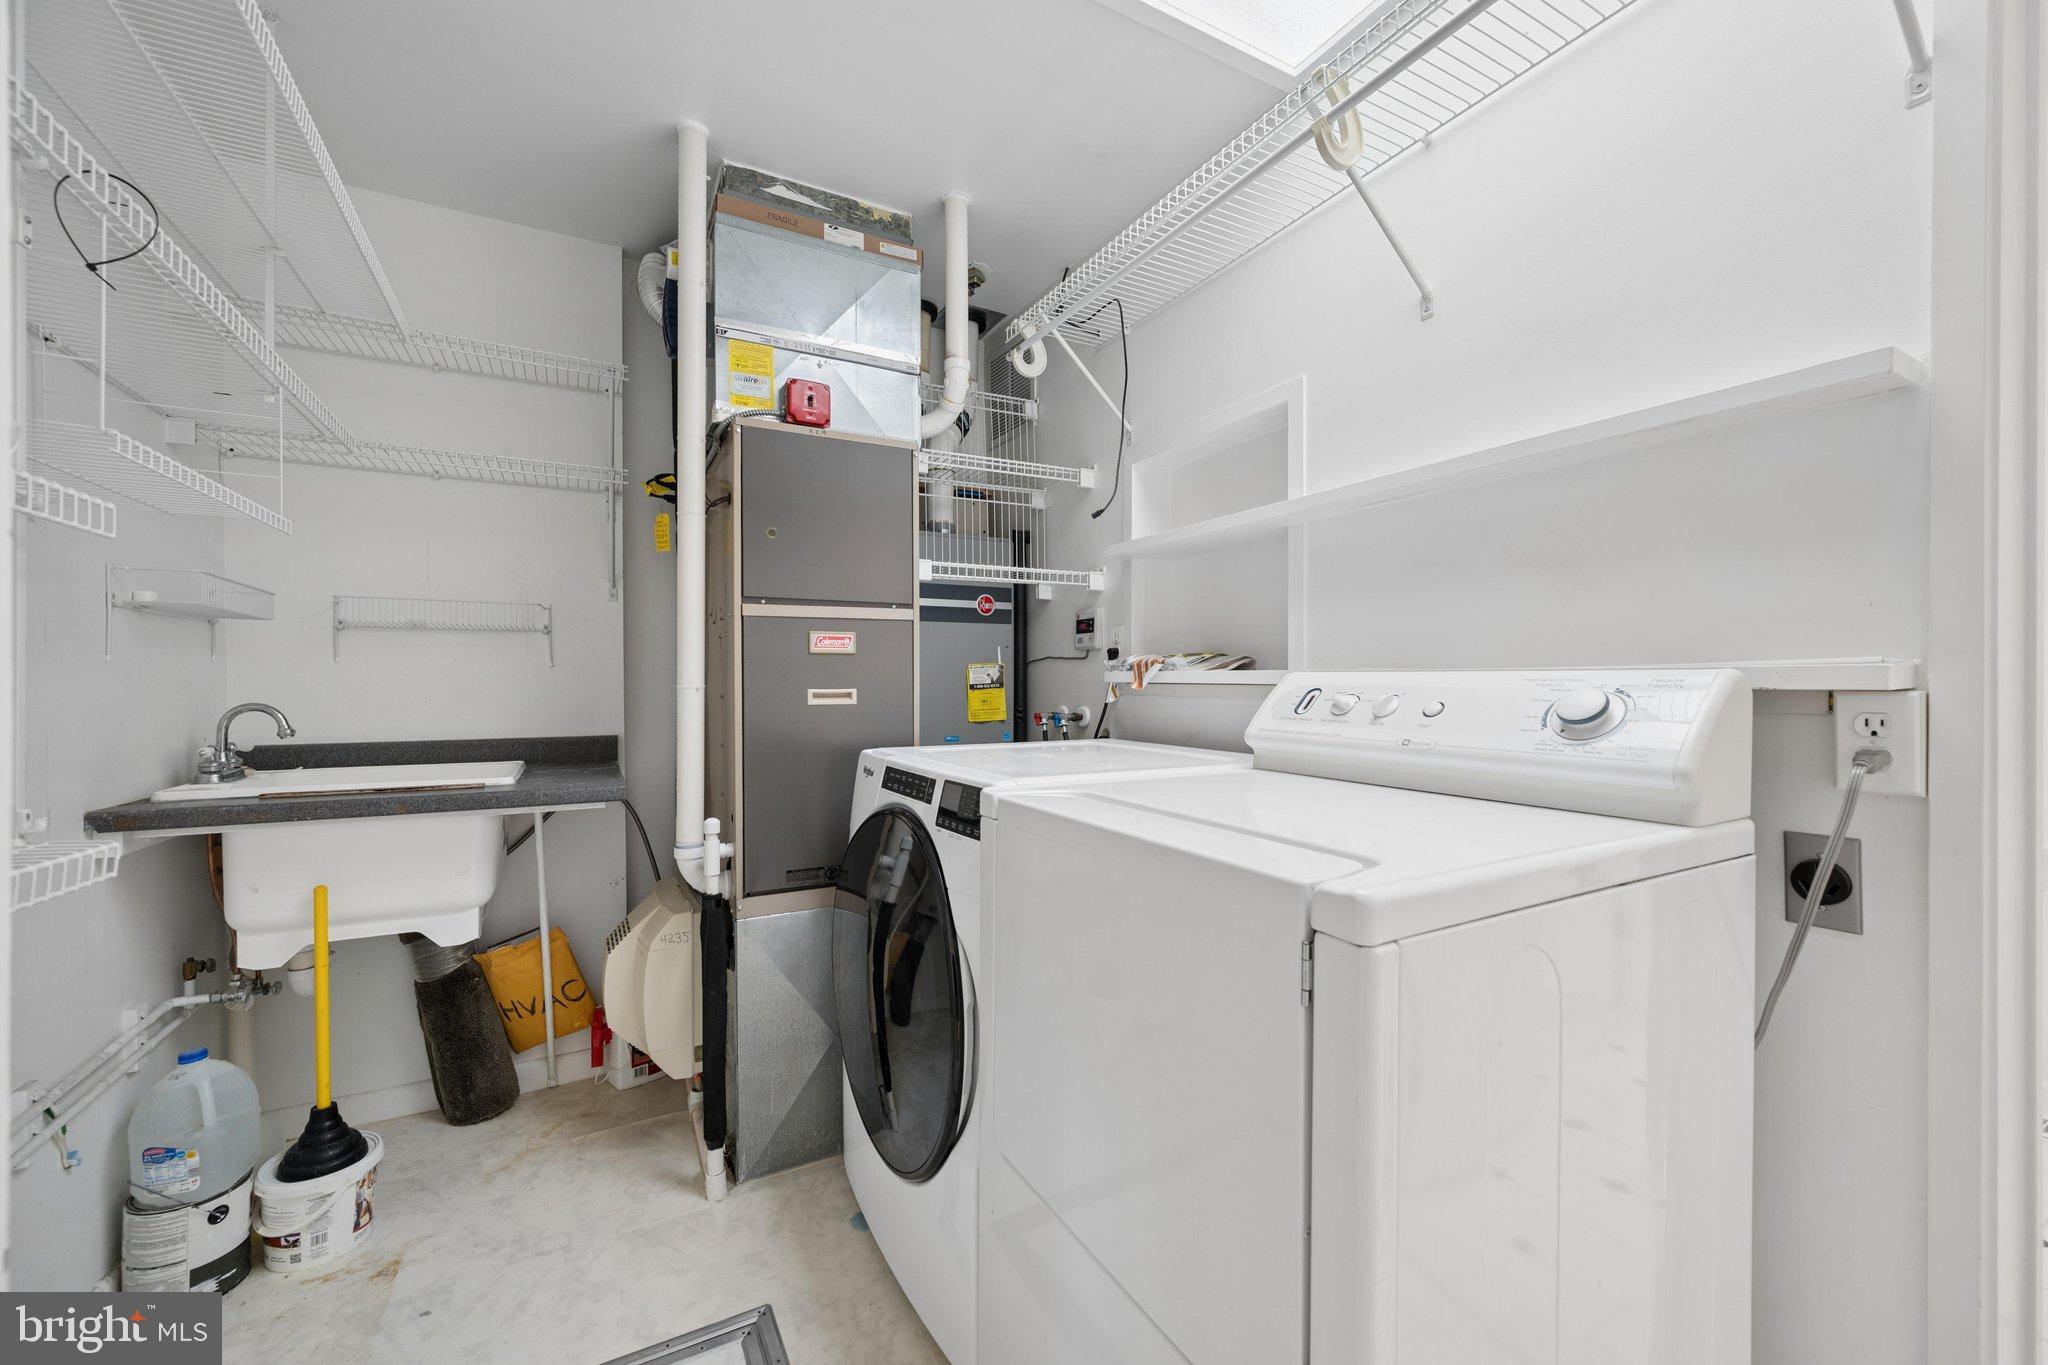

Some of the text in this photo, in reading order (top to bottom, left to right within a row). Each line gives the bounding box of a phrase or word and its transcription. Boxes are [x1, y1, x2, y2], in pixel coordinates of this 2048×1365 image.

[767, 211, 799, 227] FRAGILE
[816, 636, 844, 647] Coleman
[660, 931, 690, 944] 4235
